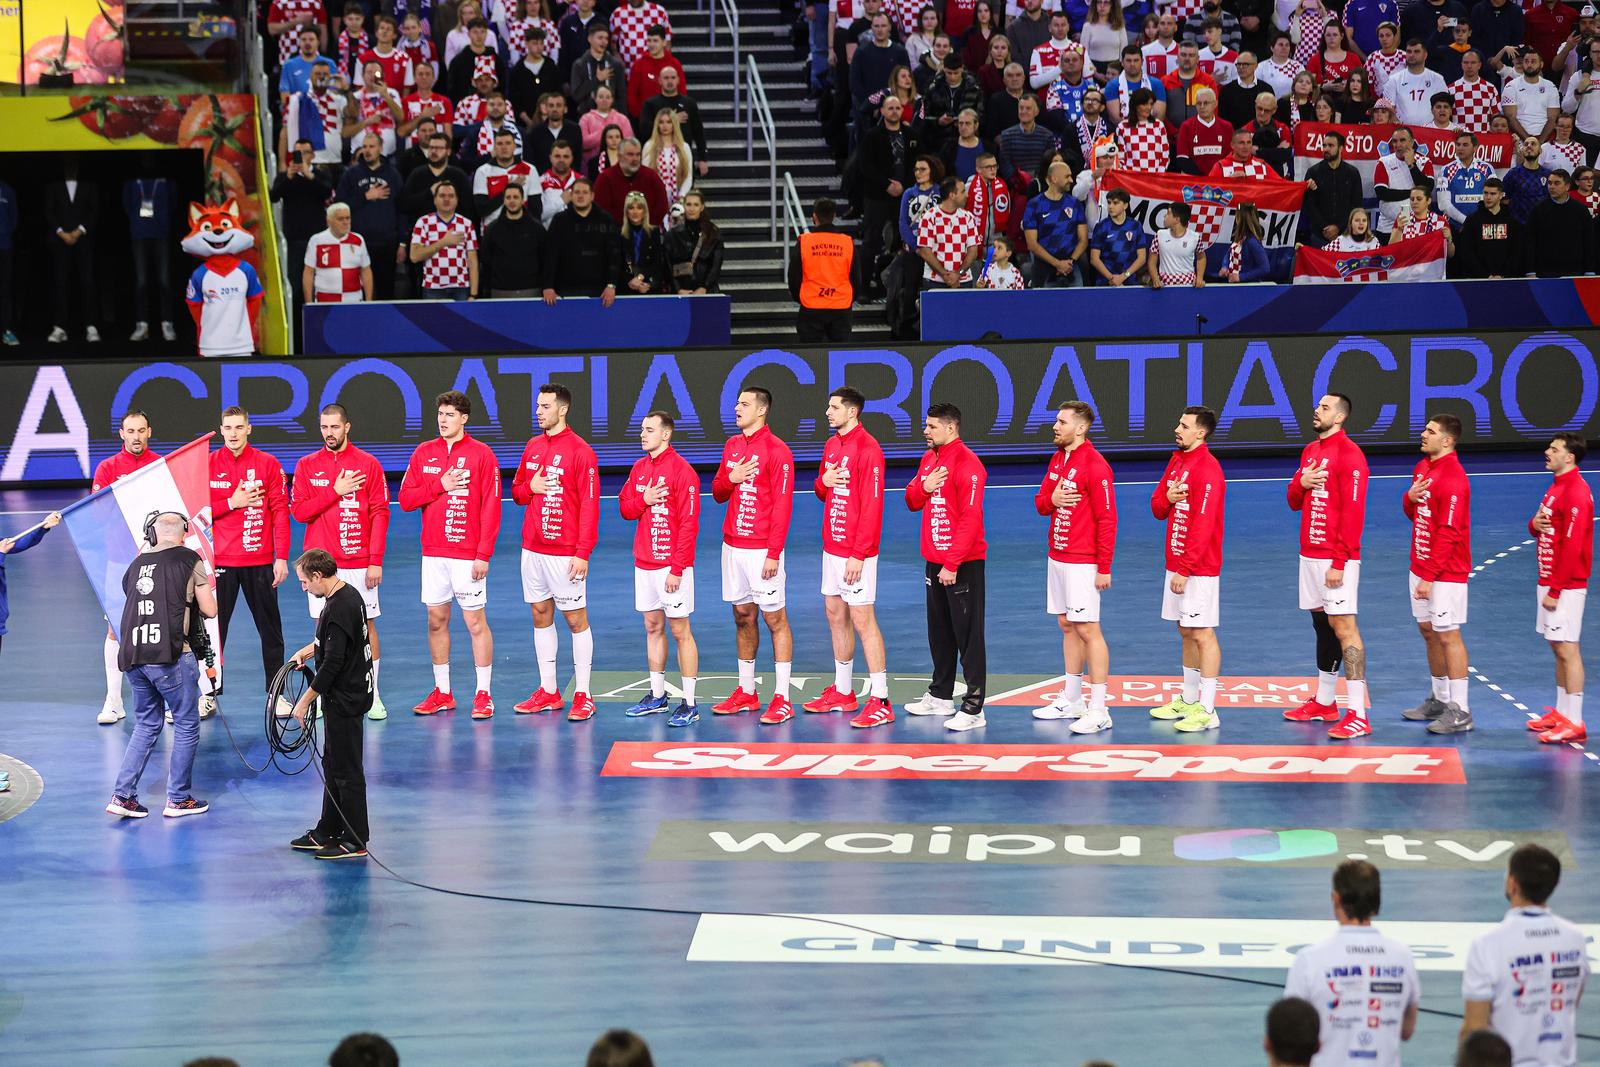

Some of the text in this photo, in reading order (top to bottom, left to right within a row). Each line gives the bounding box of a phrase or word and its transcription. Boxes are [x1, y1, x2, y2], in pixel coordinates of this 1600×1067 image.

[1409, 89, 1425, 101] 17
[1345, 130, 1373, 153] ŠTO
[1433, 140, 1458, 160] SVO
[1473, 144, 1503, 162] OLIM
[720, 341, 1304, 439] CROATIA
[1312, 331, 1598, 438] CRO
[630, 746, 1444, 779] SuperSport
[708, 825, 1142, 862] waipu
[780, 936, 1455, 961] GRUNDFS
[1345, 945, 1385, 955] CROATIA
